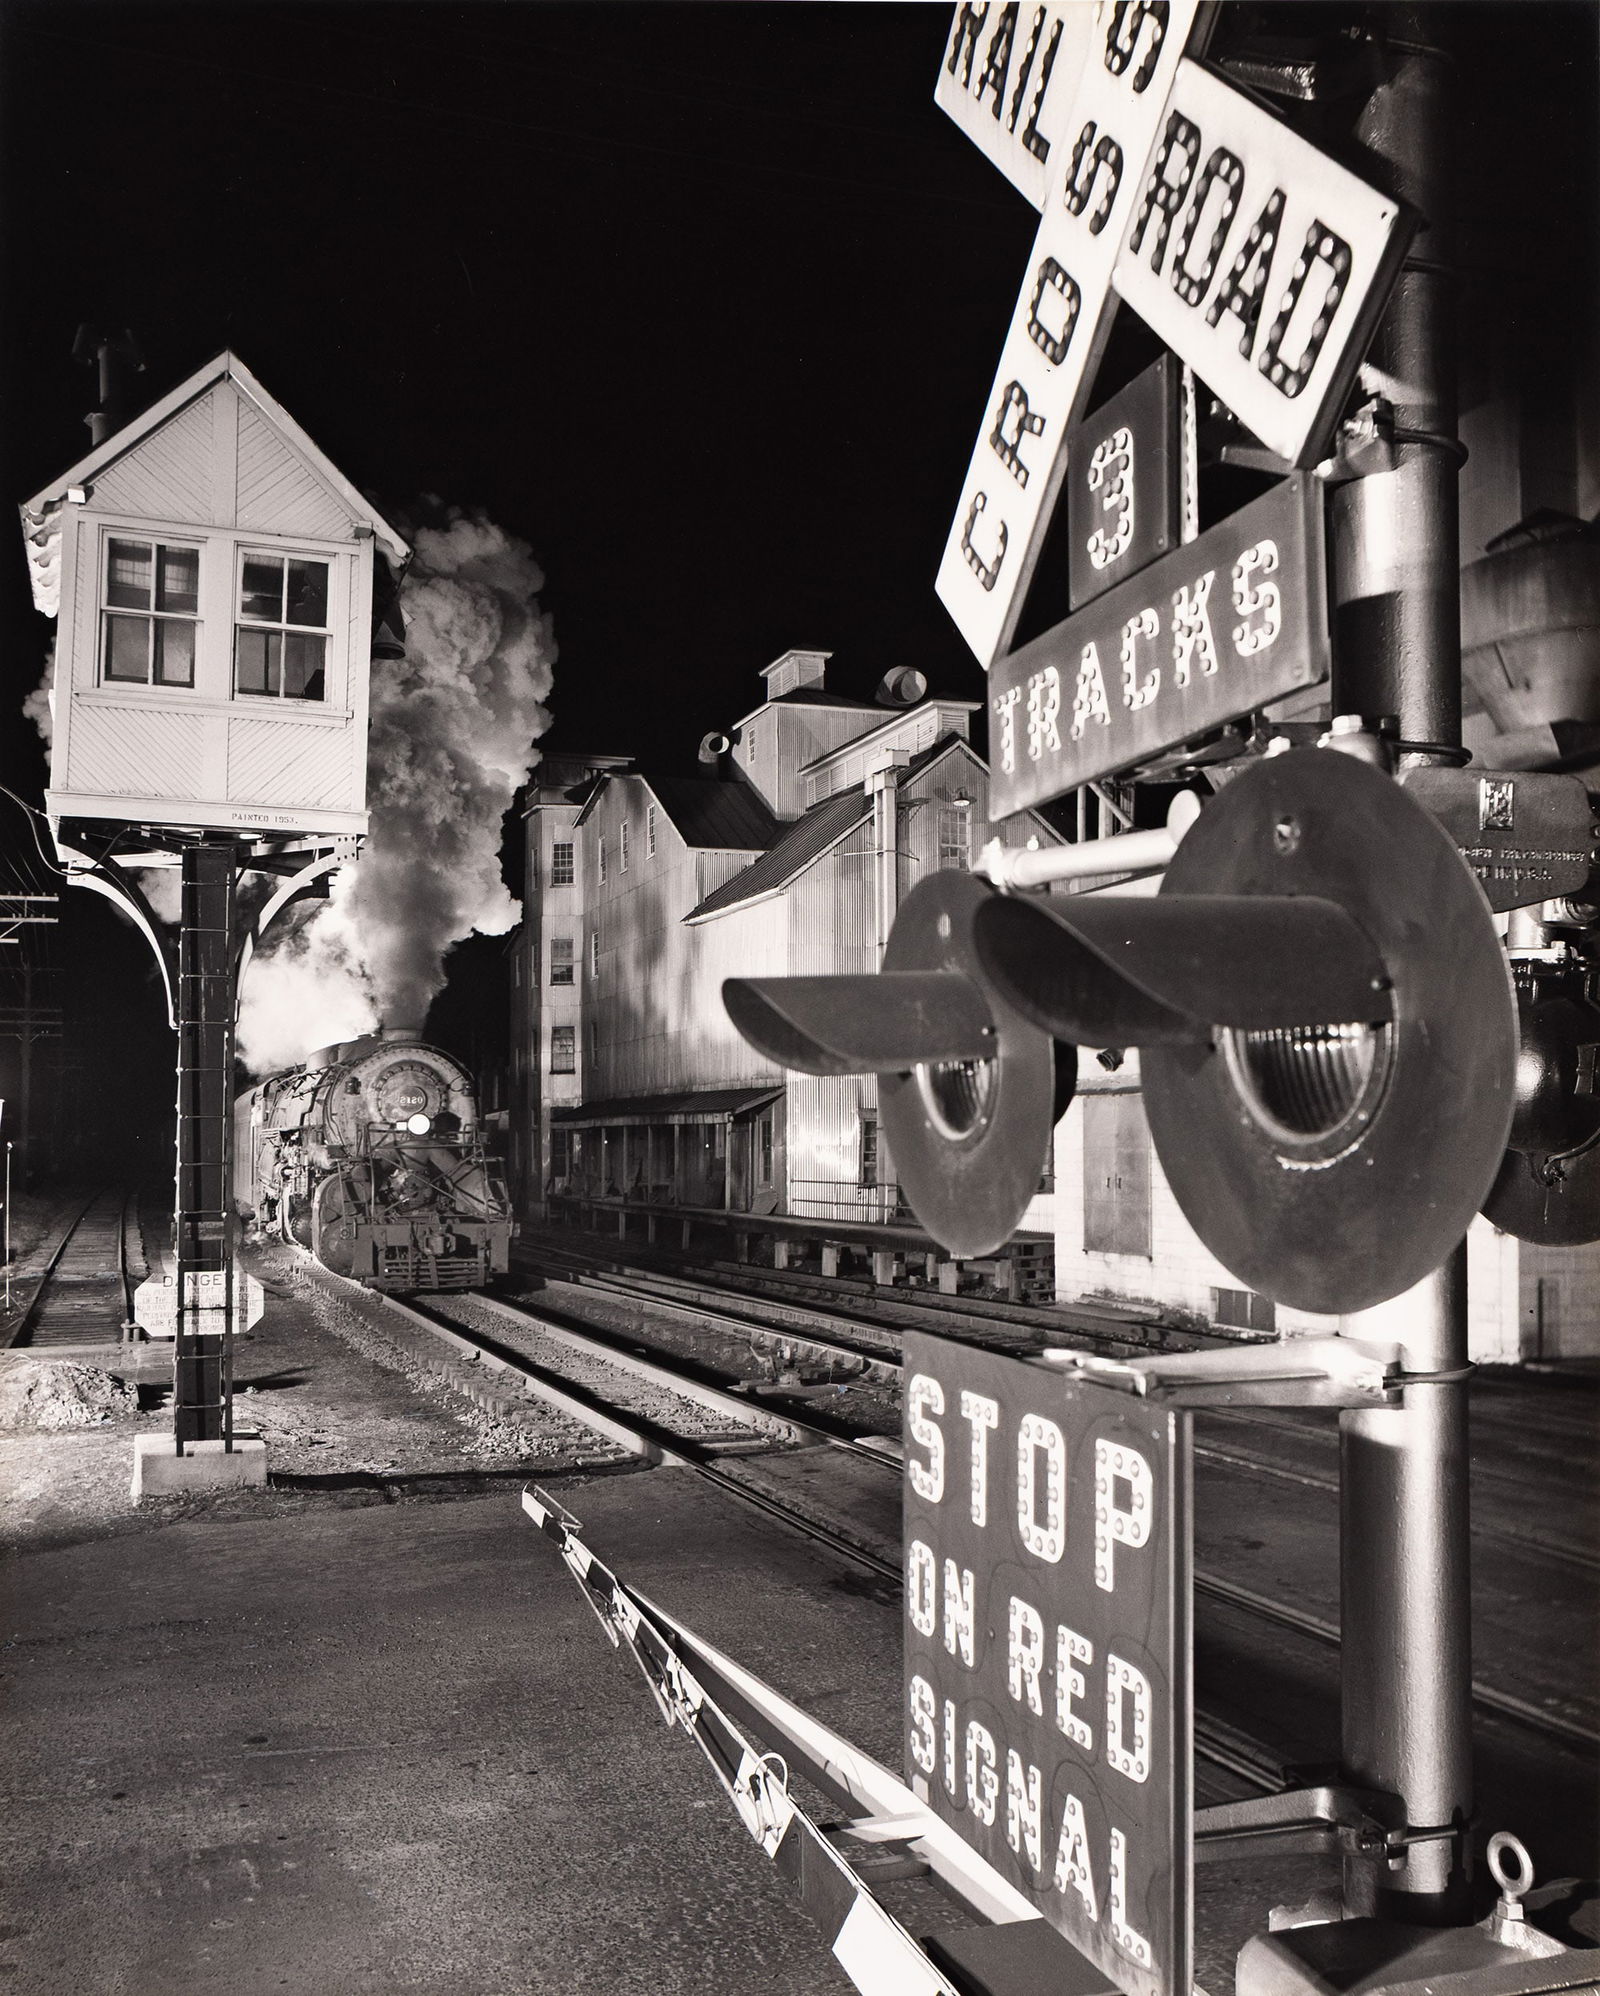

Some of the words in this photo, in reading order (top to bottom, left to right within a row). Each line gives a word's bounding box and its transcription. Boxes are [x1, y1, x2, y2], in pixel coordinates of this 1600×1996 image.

[947, 1, 1064, 165] RAIL
[1129, 109, 1353, 398] ROAD
[1088, 427, 1134, 570] 3
[993, 539, 1281, 775] TRACKS
[231, 812, 269, 823] PAINTED
[400, 1096, 423, 1105] 2120
[908, 1373, 1153, 1592] STOP
[908, 1539, 976, 1667] ON
[1008, 1595, 1153, 1783] RED
[910, 1675, 1151, 1968] SIGNAL
